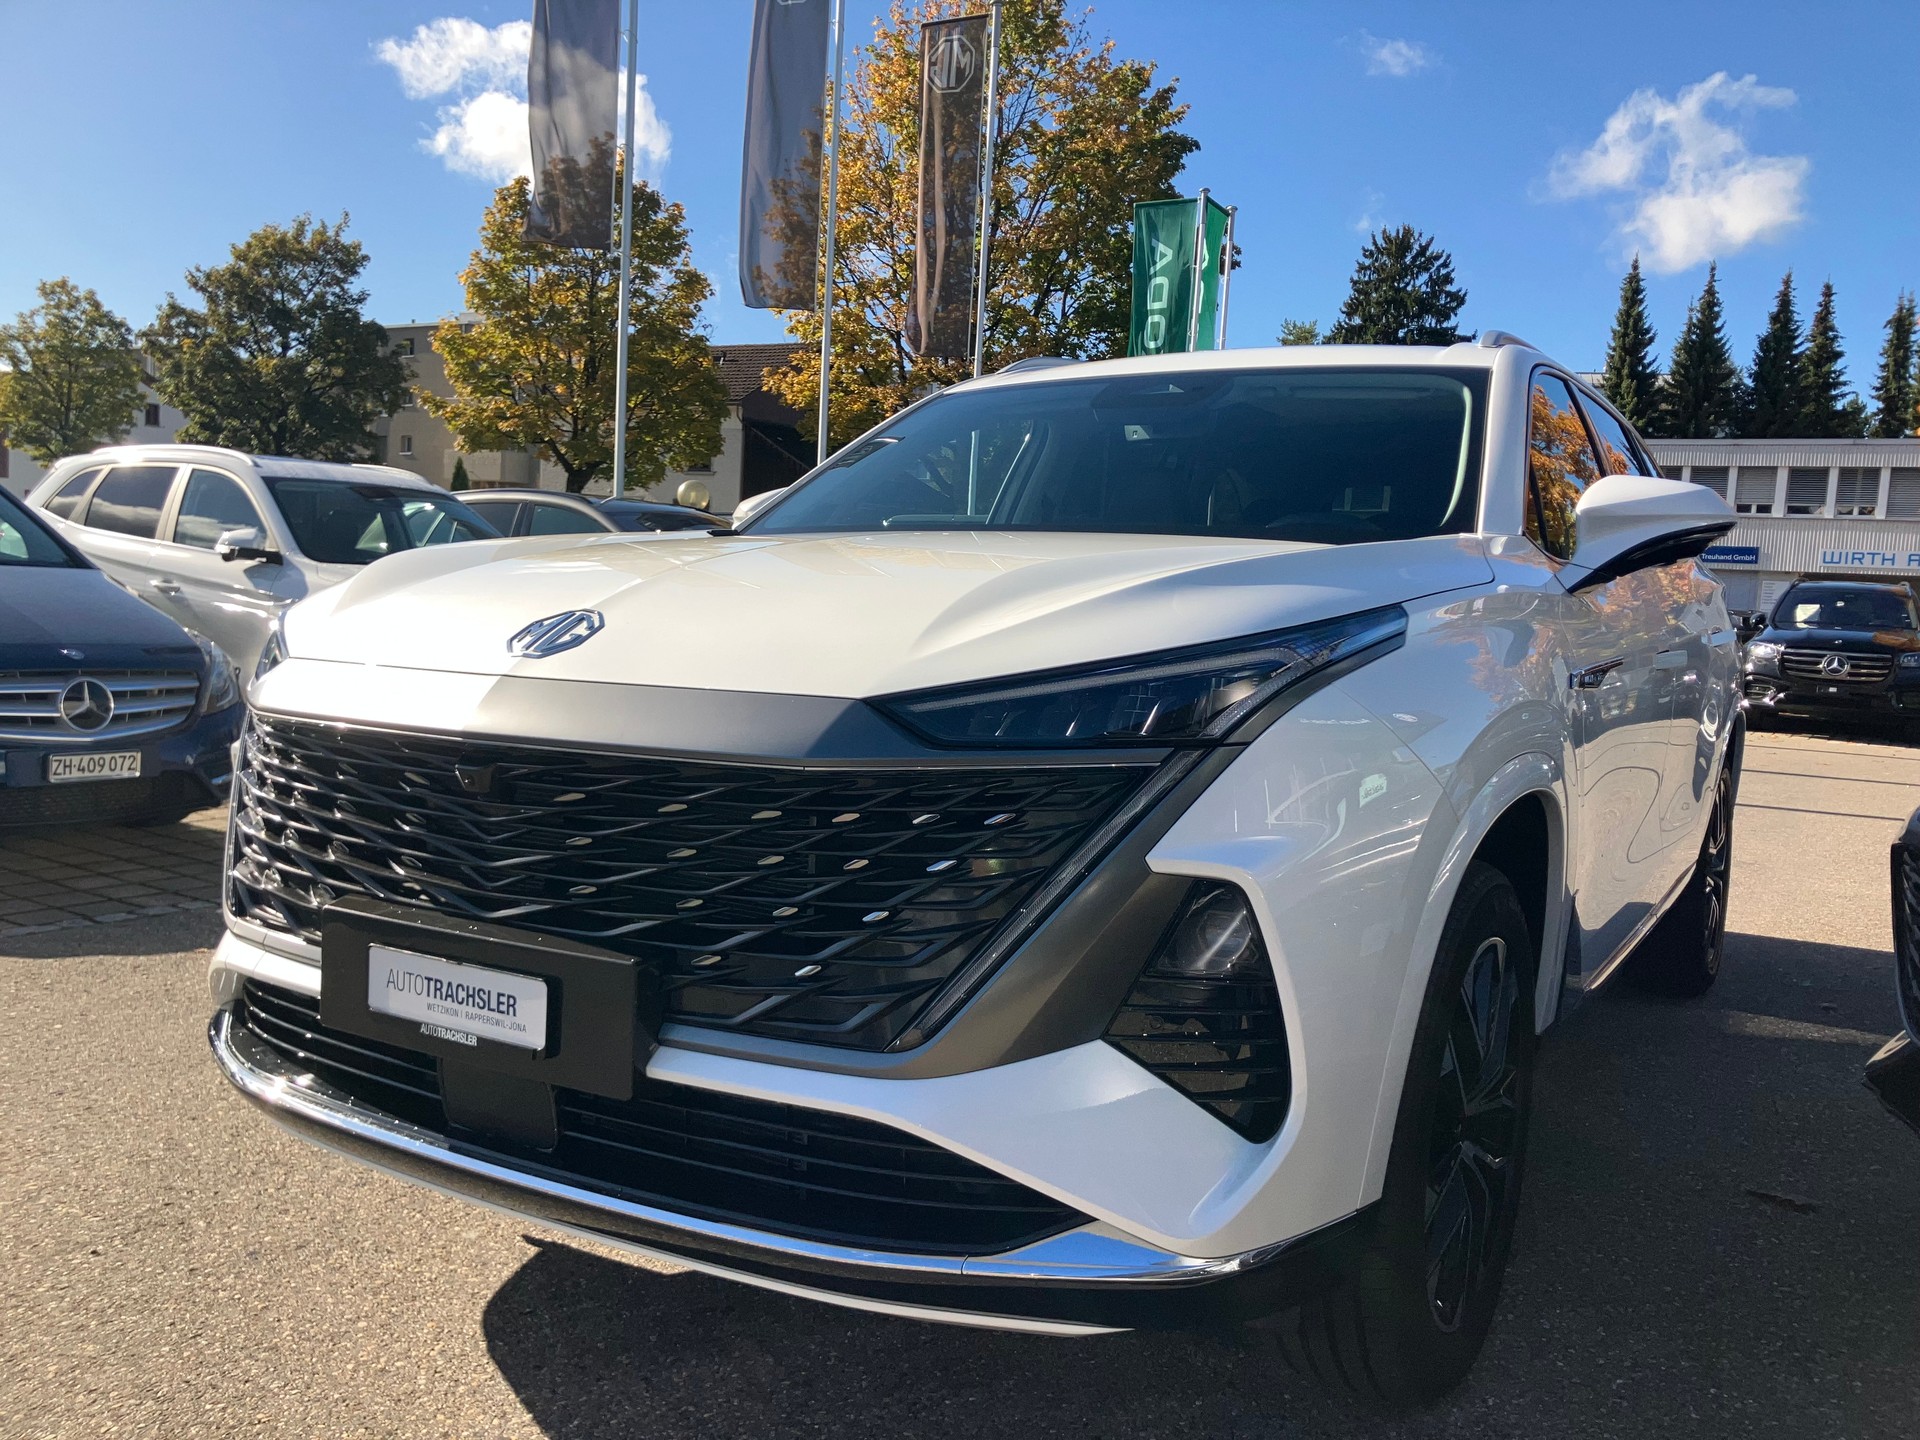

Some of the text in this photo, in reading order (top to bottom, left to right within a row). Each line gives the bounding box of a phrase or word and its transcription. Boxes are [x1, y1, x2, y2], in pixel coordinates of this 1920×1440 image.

[1701, 553, 1732, 561] Treuhand
[1822, 550, 1896, 567] WIRTH
[513, 609, 597, 654] MG
[386, 968, 517, 1017] AUTOTRACHSLER
[426, 1002, 527, 1033] WETZIKON RAPPERSWIL-JONA
[420, 1023, 478, 1047] AUTOTRACHSLER
